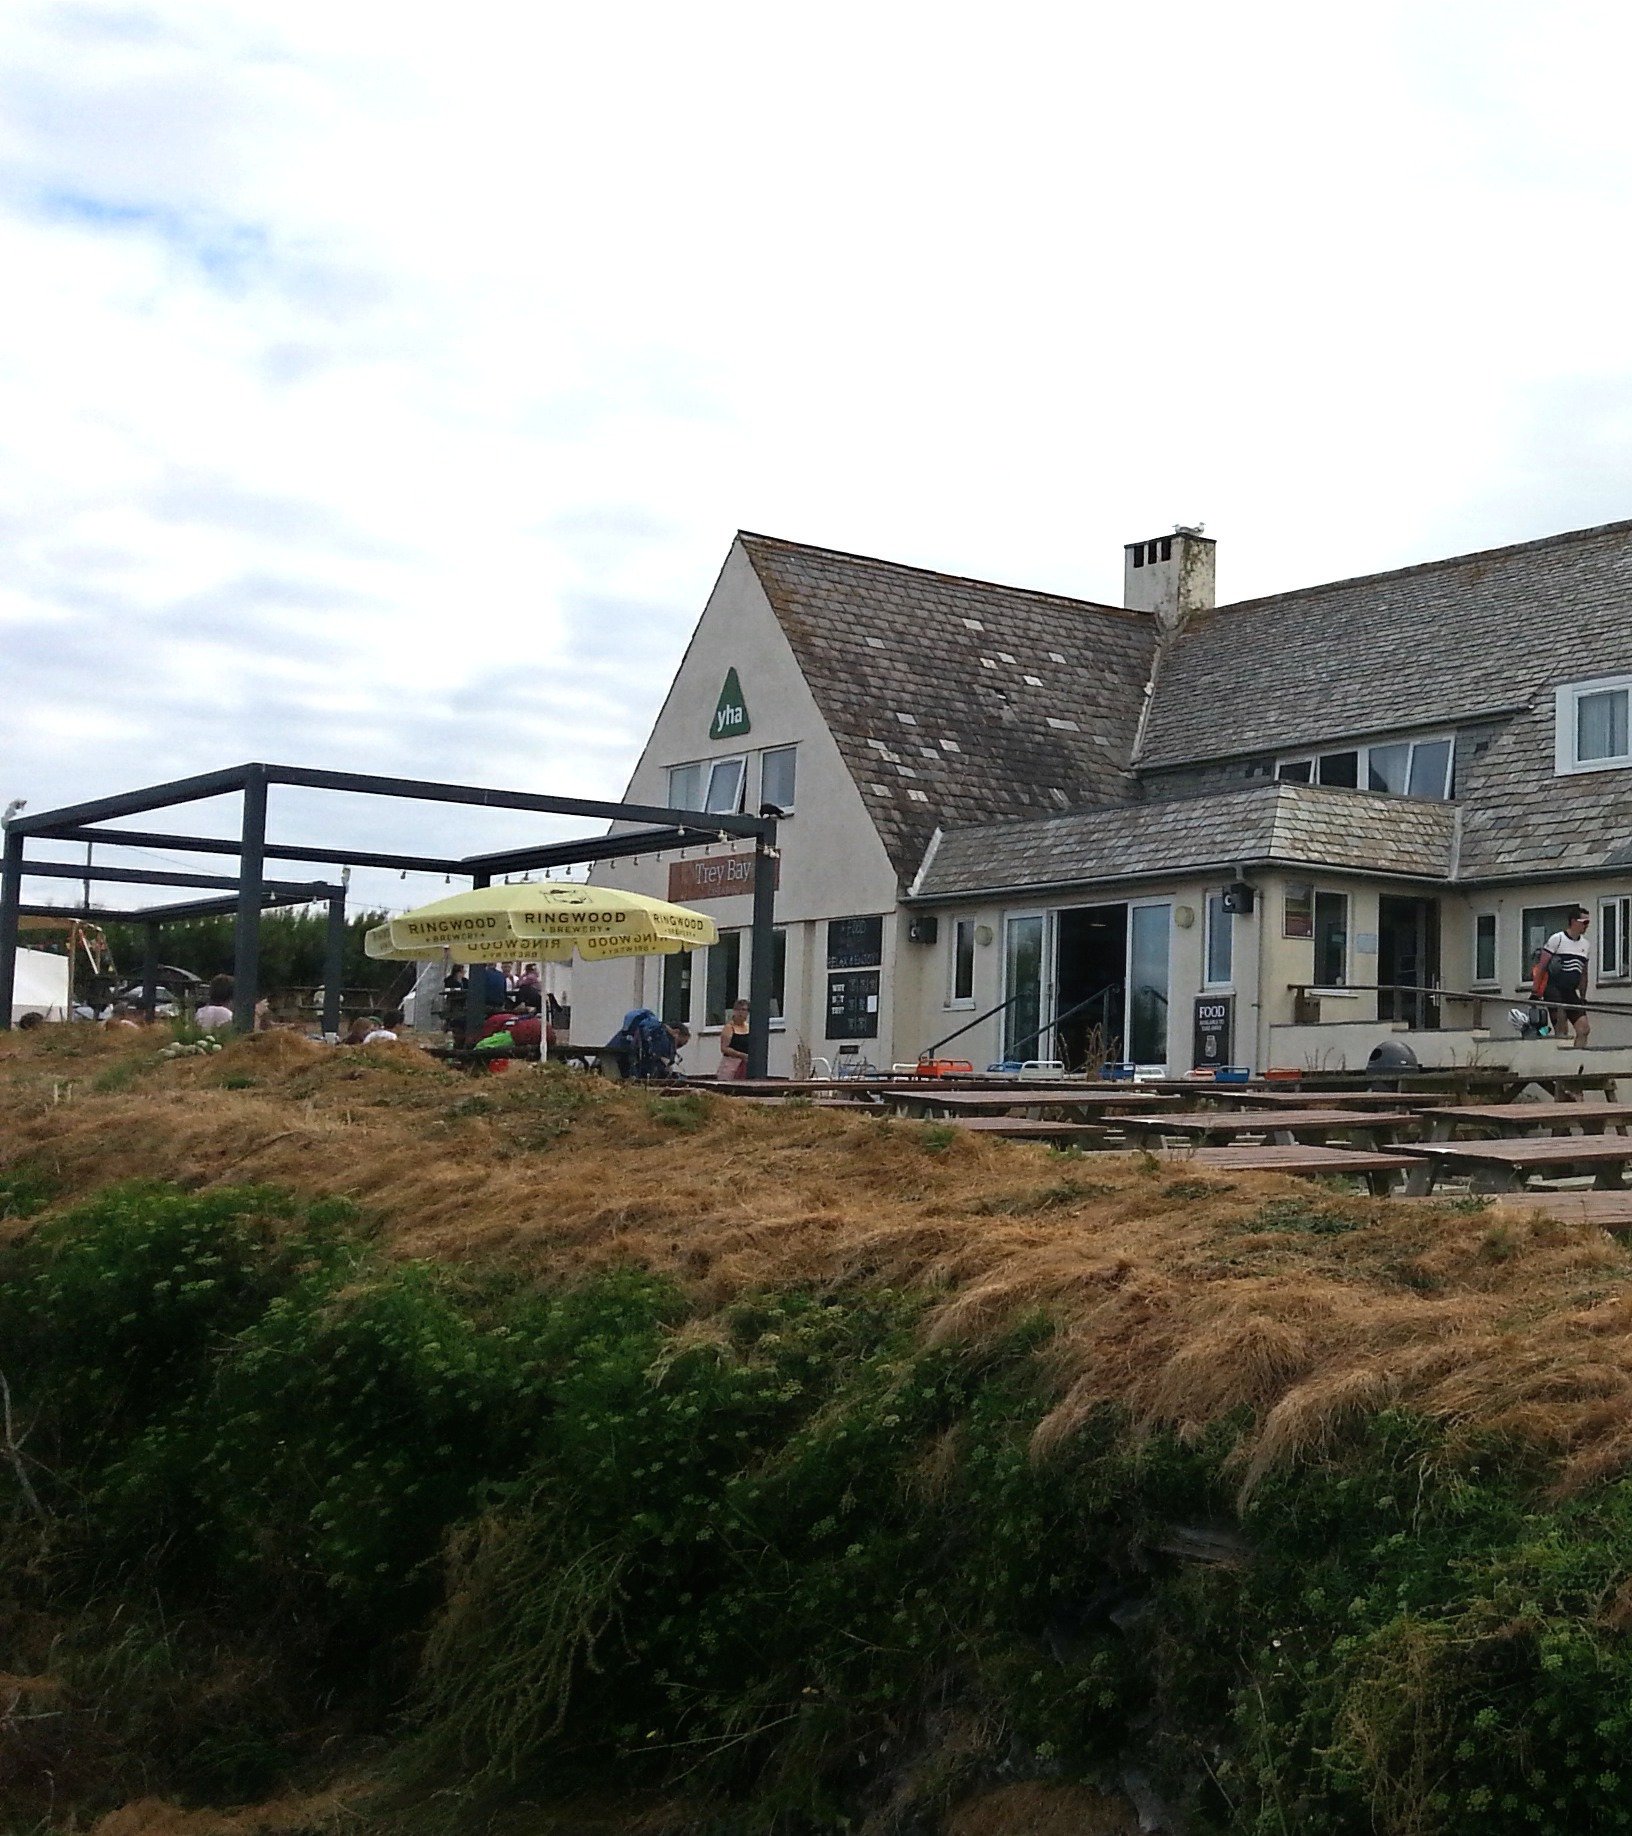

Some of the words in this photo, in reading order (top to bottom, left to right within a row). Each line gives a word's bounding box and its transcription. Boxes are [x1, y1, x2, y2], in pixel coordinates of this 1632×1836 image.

[717, 704, 743, 733] yha
[695, 862, 725, 885] Trey
[727, 859, 752, 882] Bay
[525, 912, 627, 924] RINGWOOD
[653, 912, 704, 931] RINGWOOD
[408, 917, 496, 935] RINGWOOD
[549, 925, 602, 934] BREWERY
[433, 932, 479, 943] BREWERY
[1199, 1006, 1225, 1018] FOOD
